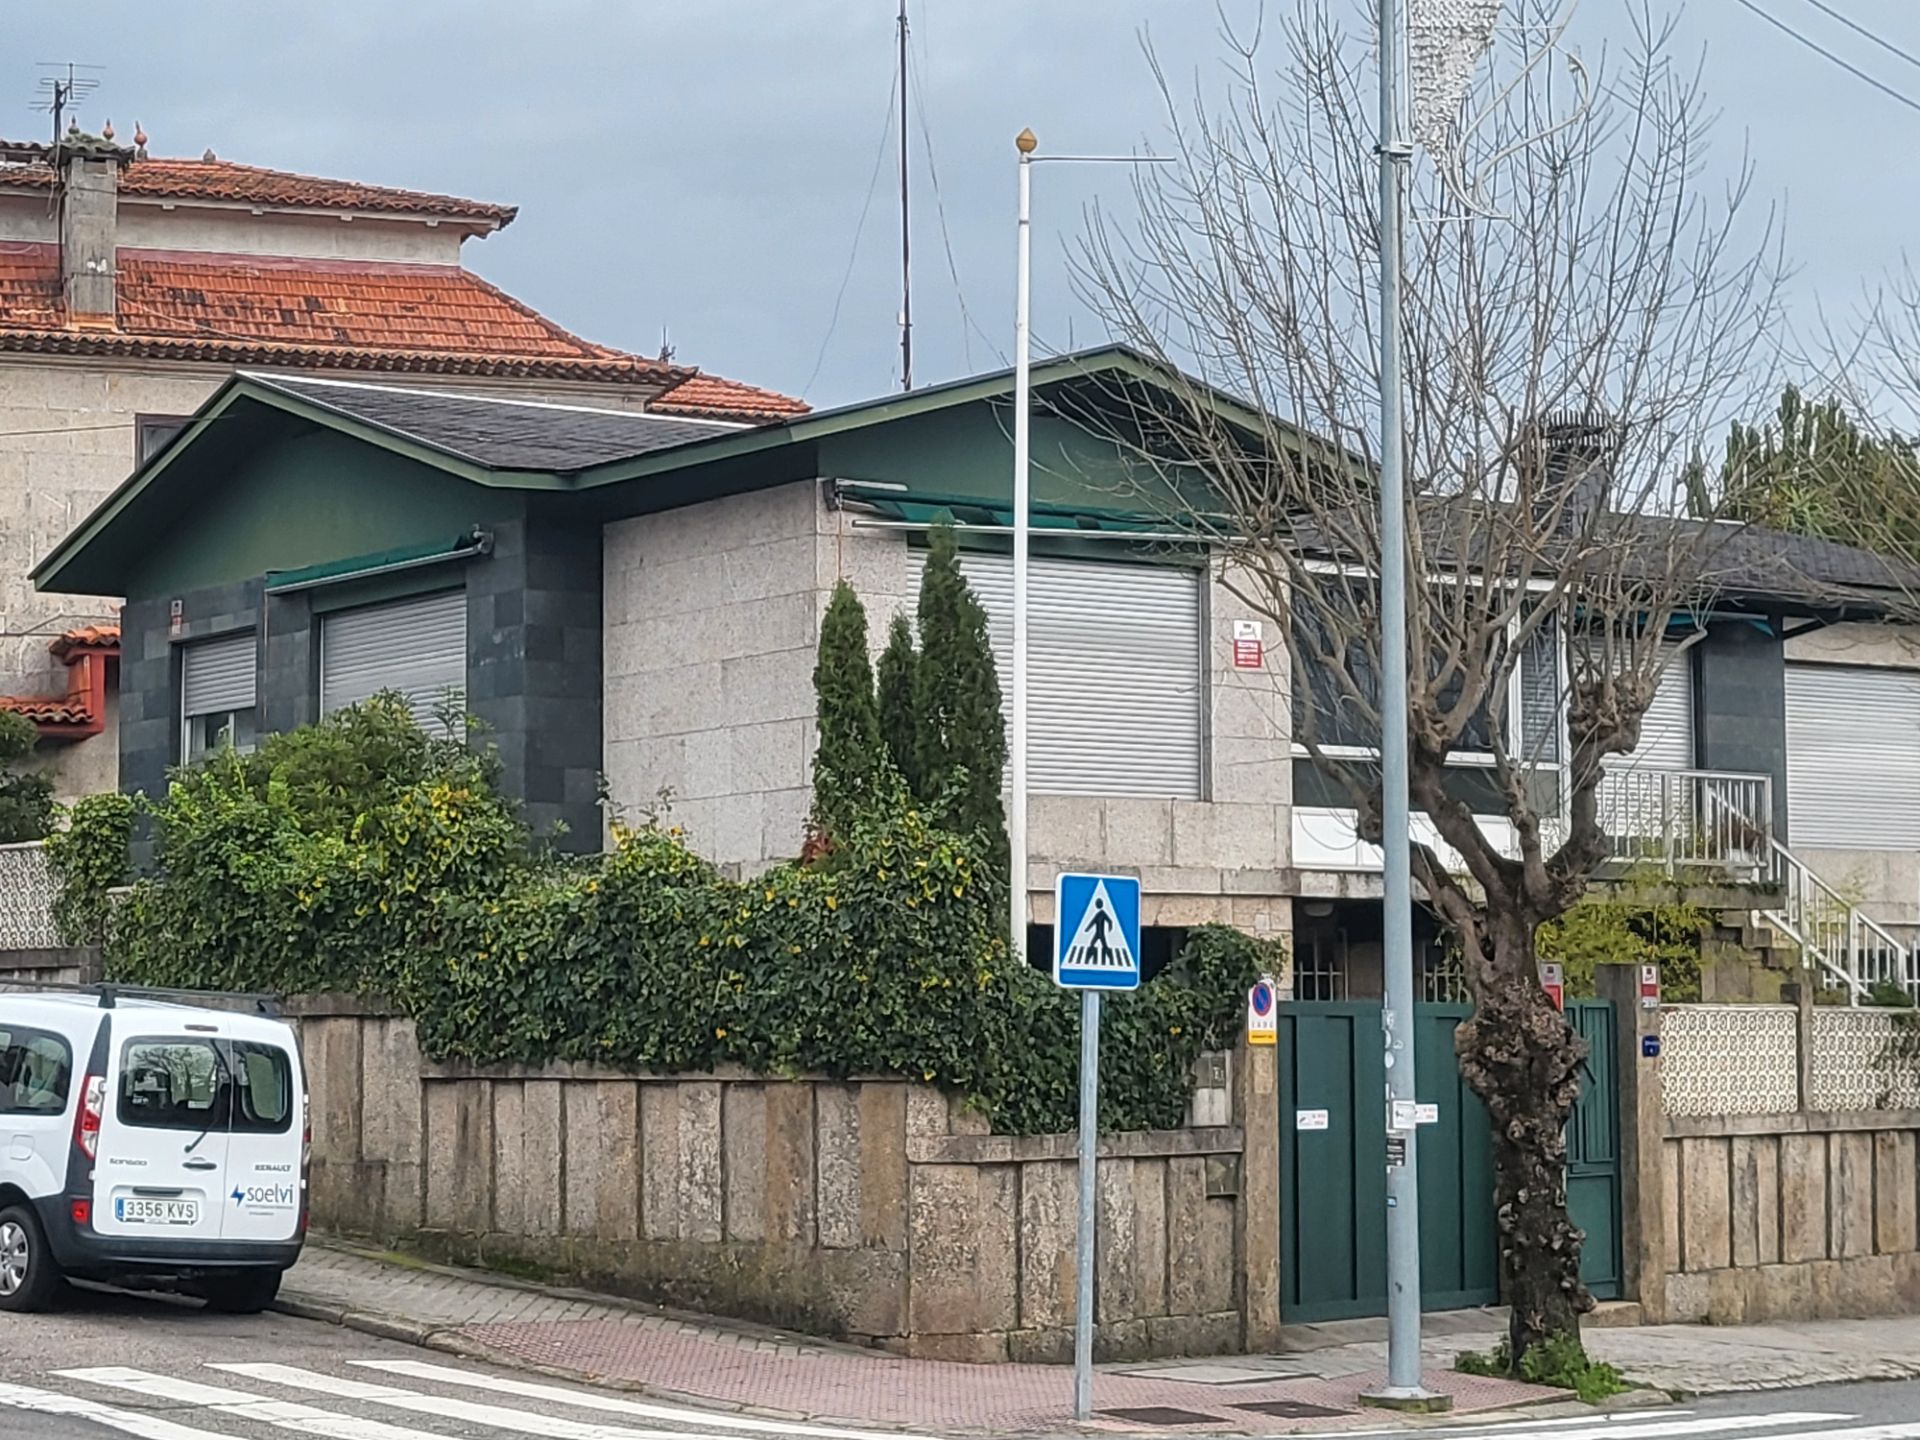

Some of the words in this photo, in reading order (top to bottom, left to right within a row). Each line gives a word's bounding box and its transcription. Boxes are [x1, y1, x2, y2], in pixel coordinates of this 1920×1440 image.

[254, 1164, 292, 1172] RENAULT
[247, 1183, 294, 1204] soelvi
[126, 1201, 163, 1217] 3356
[167, 1203, 194, 1218] KVS
